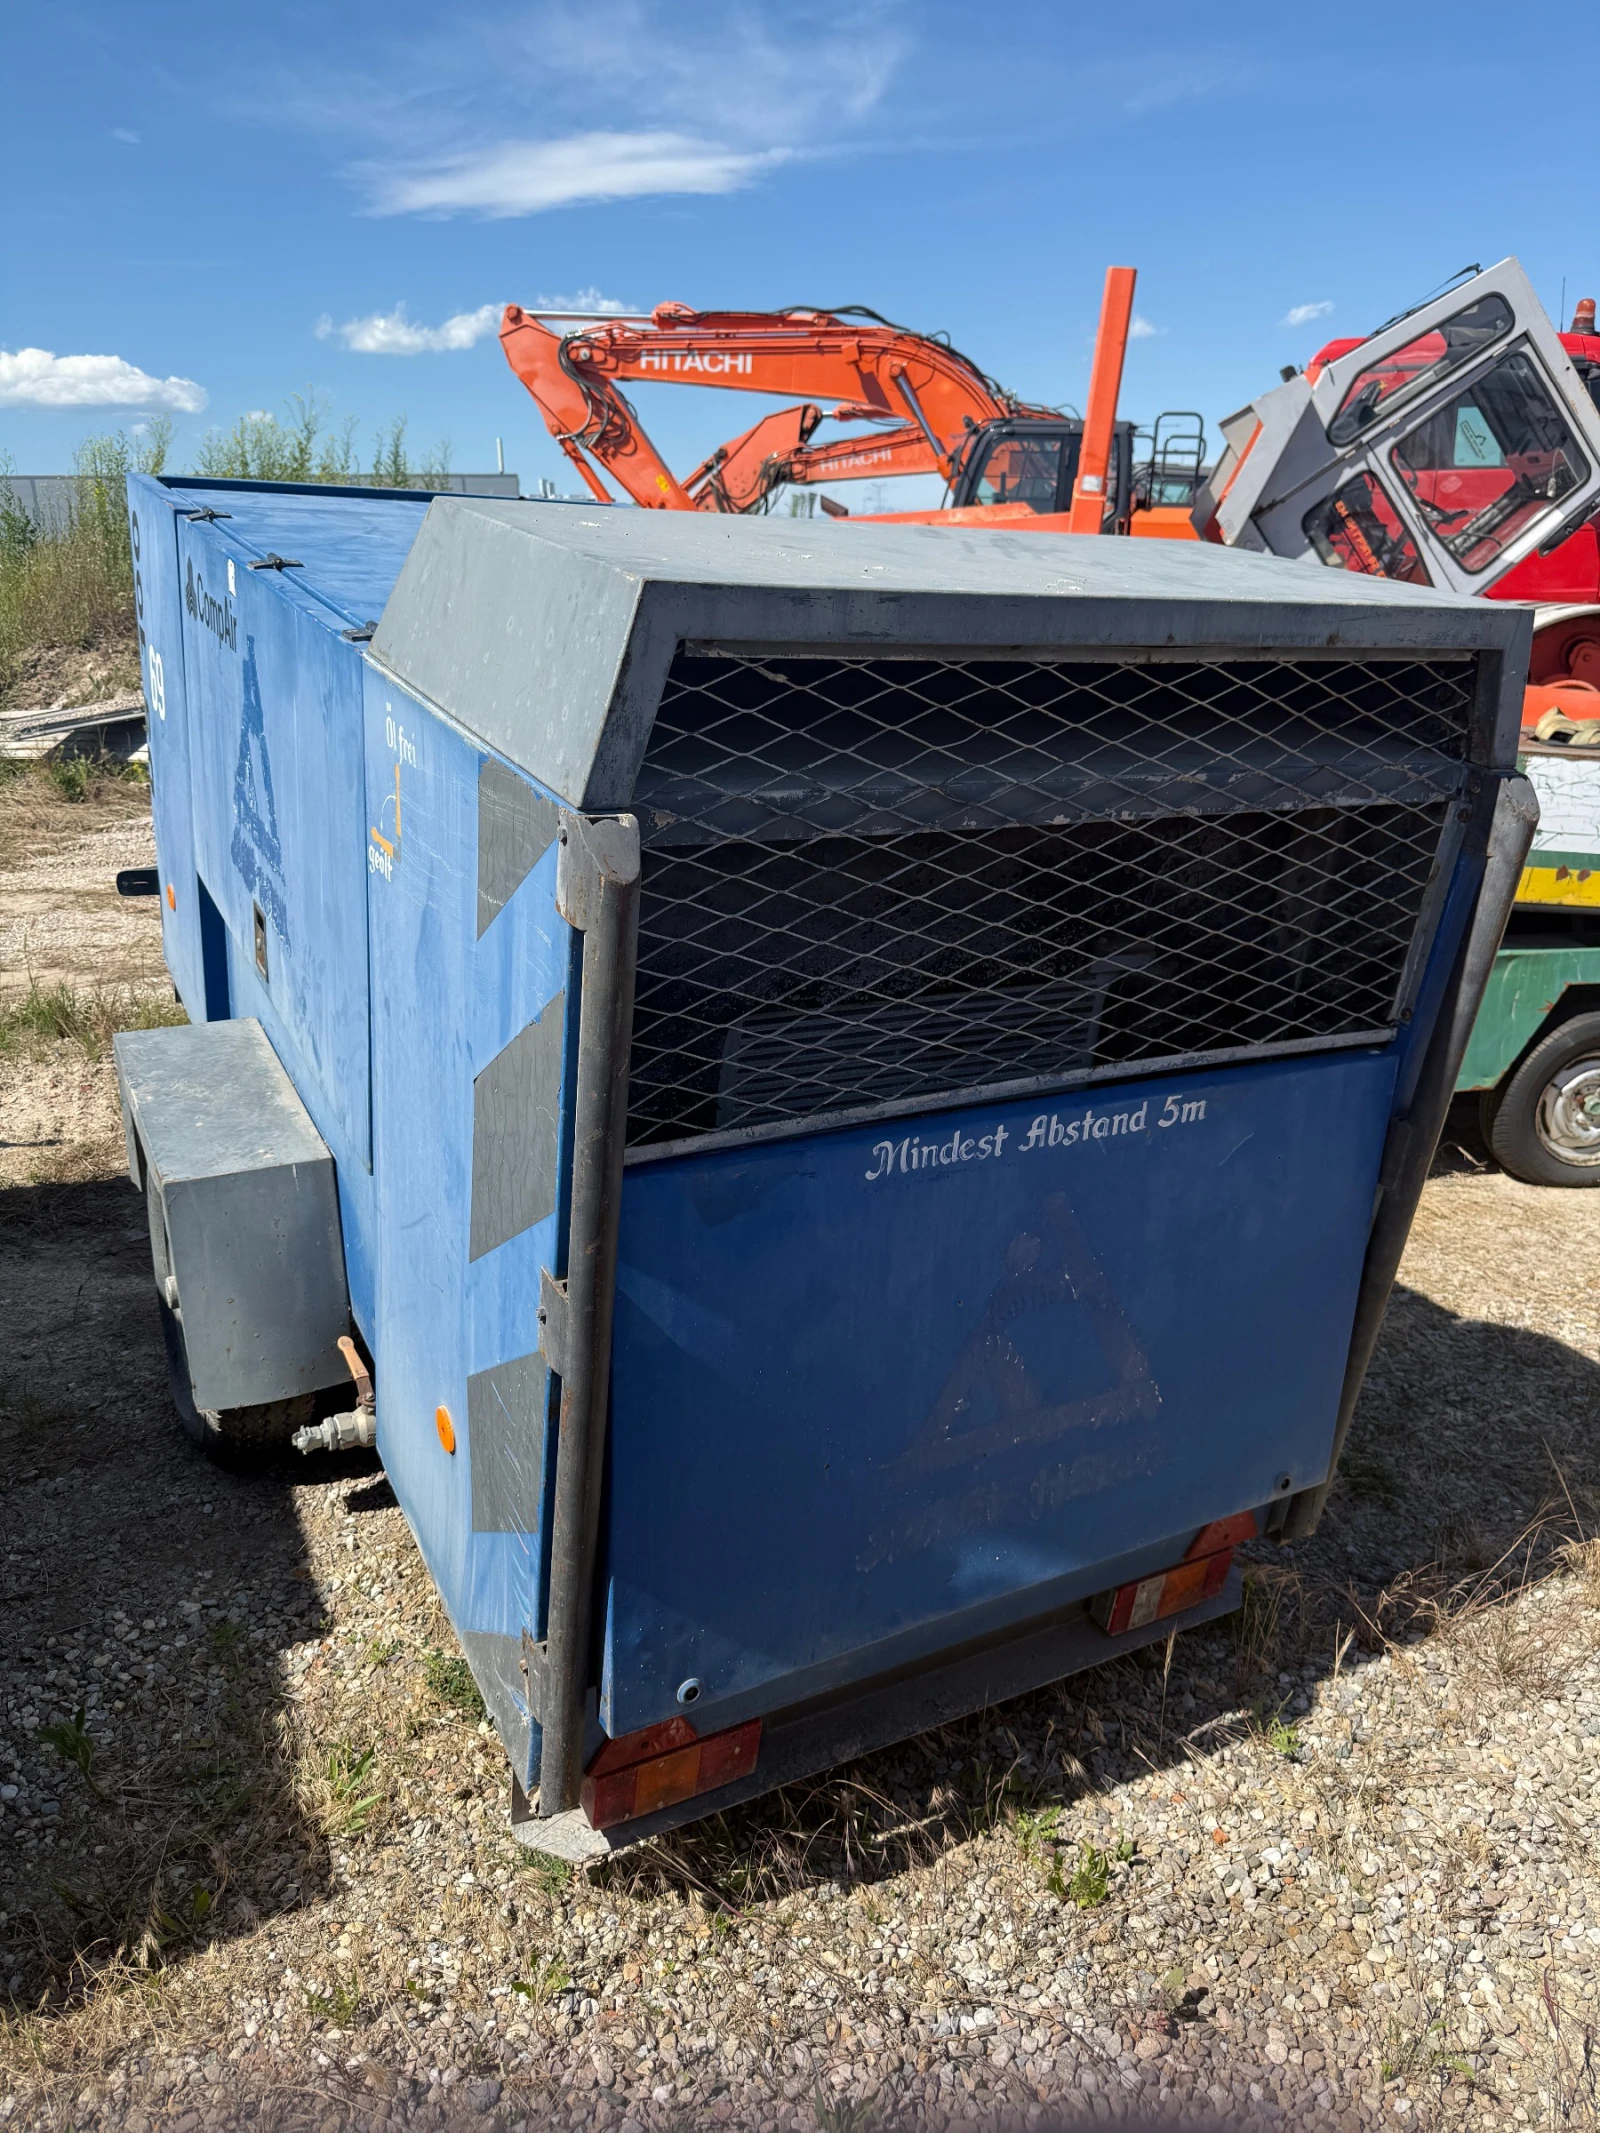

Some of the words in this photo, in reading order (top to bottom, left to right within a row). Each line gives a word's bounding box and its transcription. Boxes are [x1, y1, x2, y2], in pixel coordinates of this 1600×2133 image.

[640, 350, 753, 374] HITACHI
[820, 449, 892, 472] HITACHI
[196, 572, 238, 654] CompAir
[149, 643, 166, 721] 69
[398, 731, 417, 769] frei
[368, 844, 393, 883] geölt
[865, 1124, 1009, 1181] Mindest
[1017, 1099, 1149, 1153] Abstand
[1157, 1094, 1207, 1128] 5m
